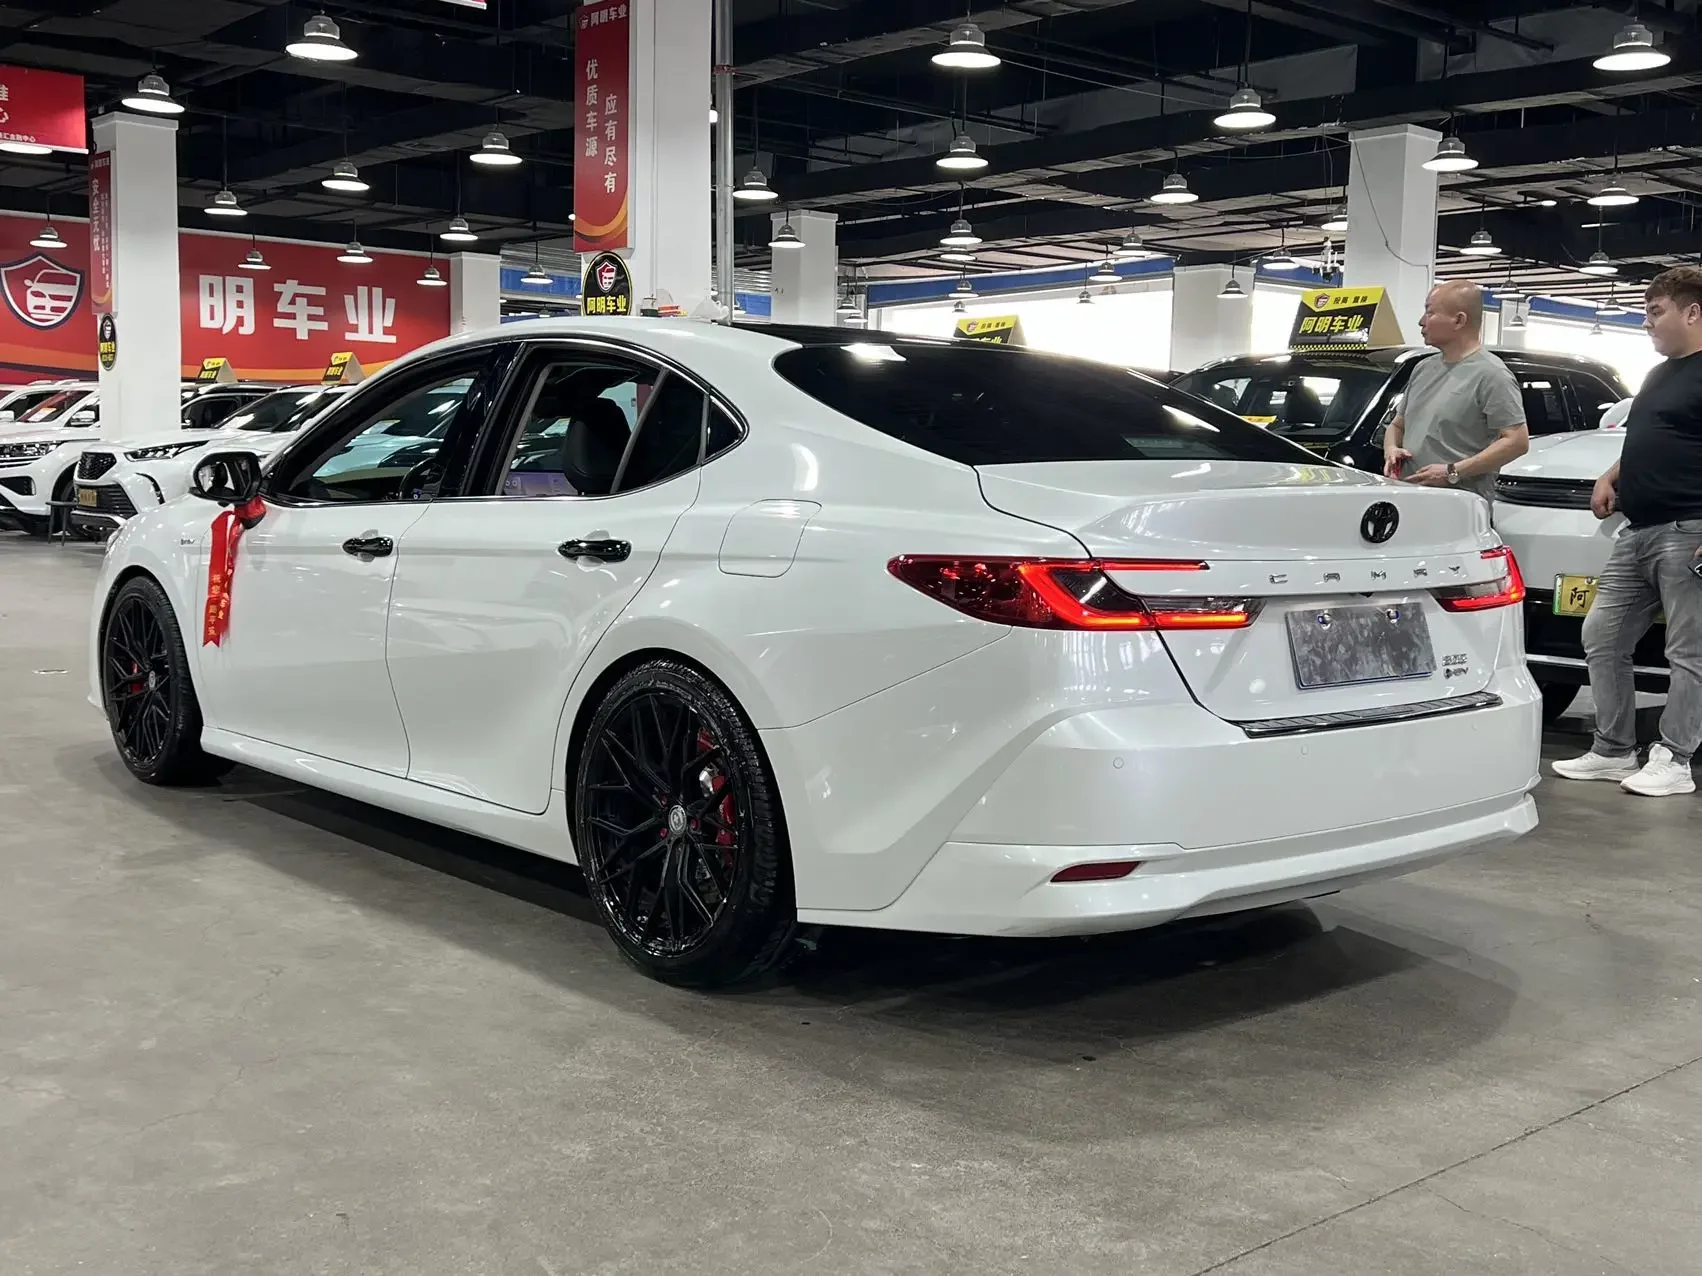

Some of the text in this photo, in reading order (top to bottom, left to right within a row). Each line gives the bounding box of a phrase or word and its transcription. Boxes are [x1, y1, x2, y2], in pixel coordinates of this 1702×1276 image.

[590, 4, 627, 27] 阿明车业
[585, 58, 599, 157] 优质车源
[604, 93, 617, 193] 应有尽有
[199, 274, 397, 343] 明车业
[586, 295, 626, 314] 阿明车业
[1298, 314, 1364, 334] 阿明车业
[1570, 587, 1590, 608] 阿
